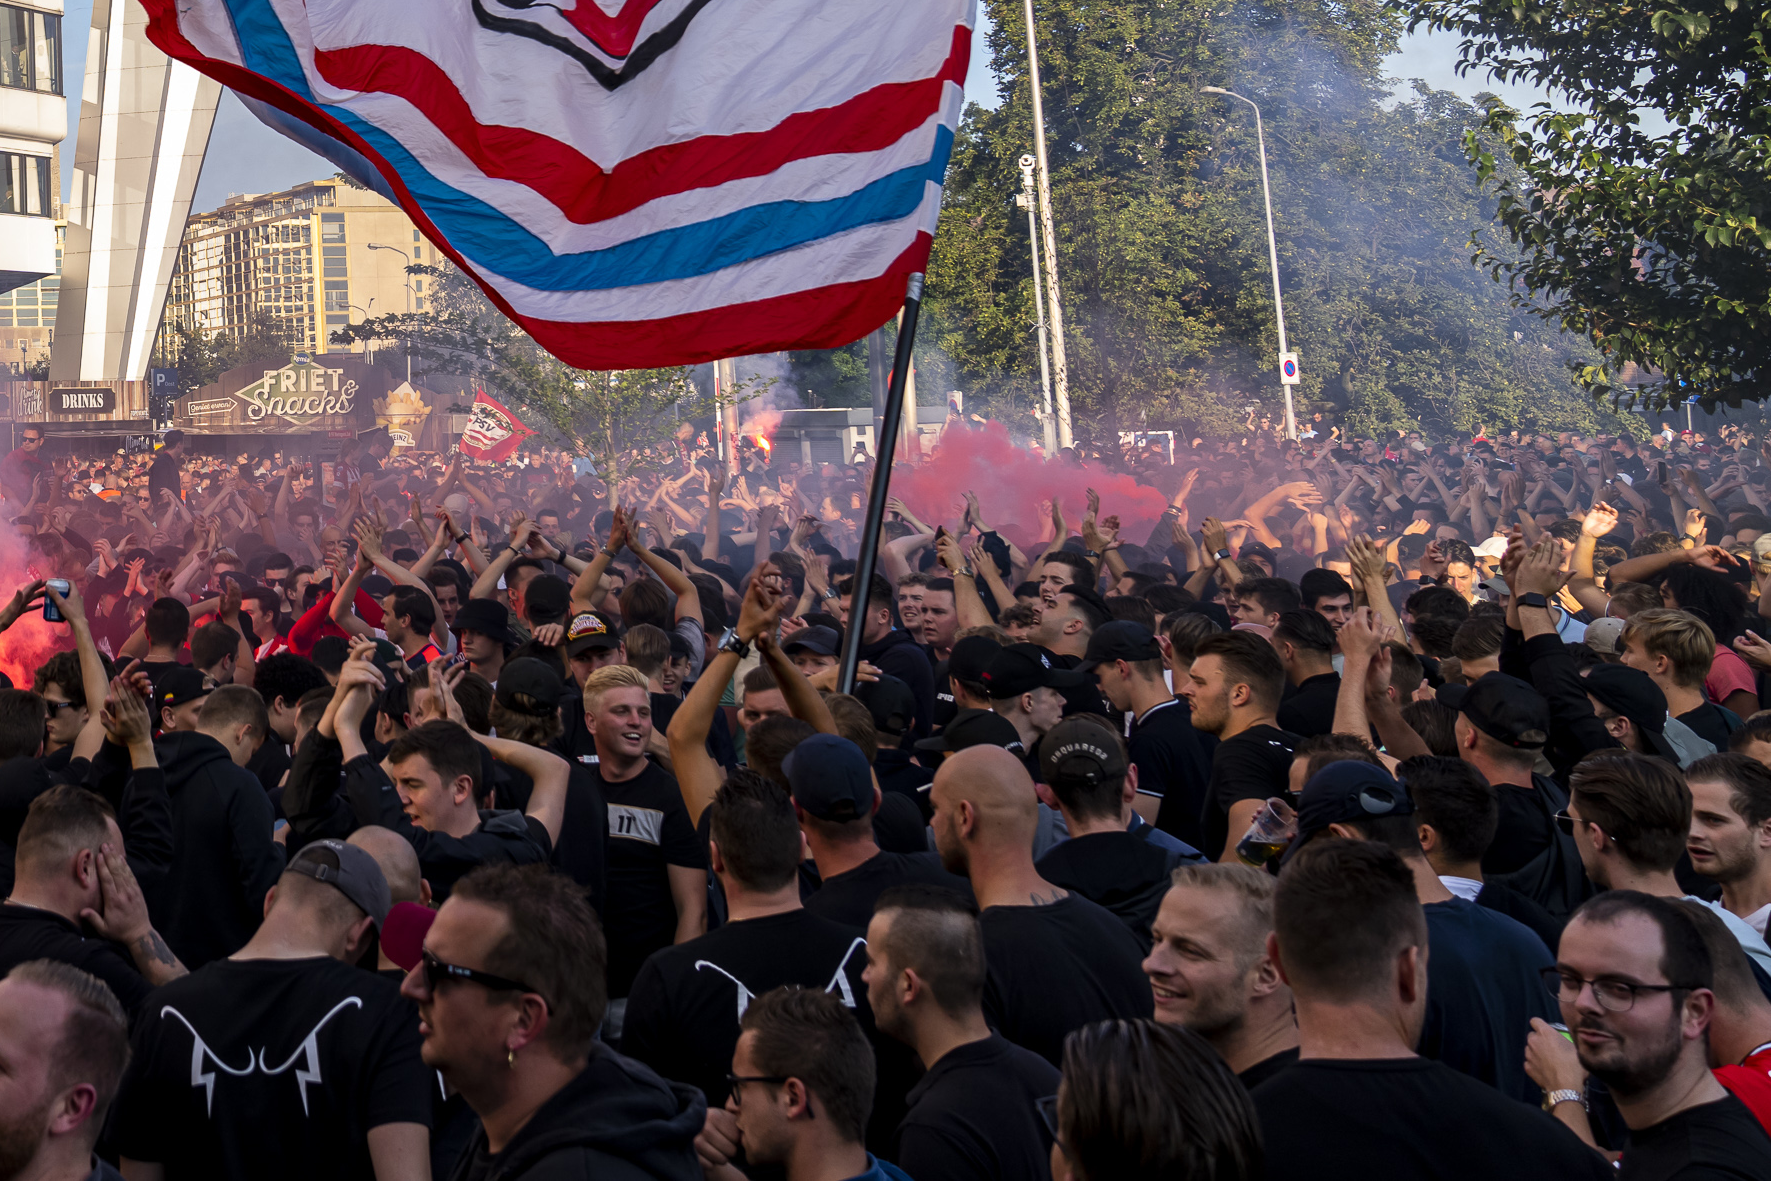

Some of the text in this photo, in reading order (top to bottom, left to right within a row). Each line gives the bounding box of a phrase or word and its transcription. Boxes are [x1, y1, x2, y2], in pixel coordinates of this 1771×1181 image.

[156, 373, 166, 387] P
[263, 369, 344, 392] FRIET
[62, 393, 104, 409] DRINKS
[248, 388, 355, 420] Snacks
[472, 419, 496, 433] PSV
